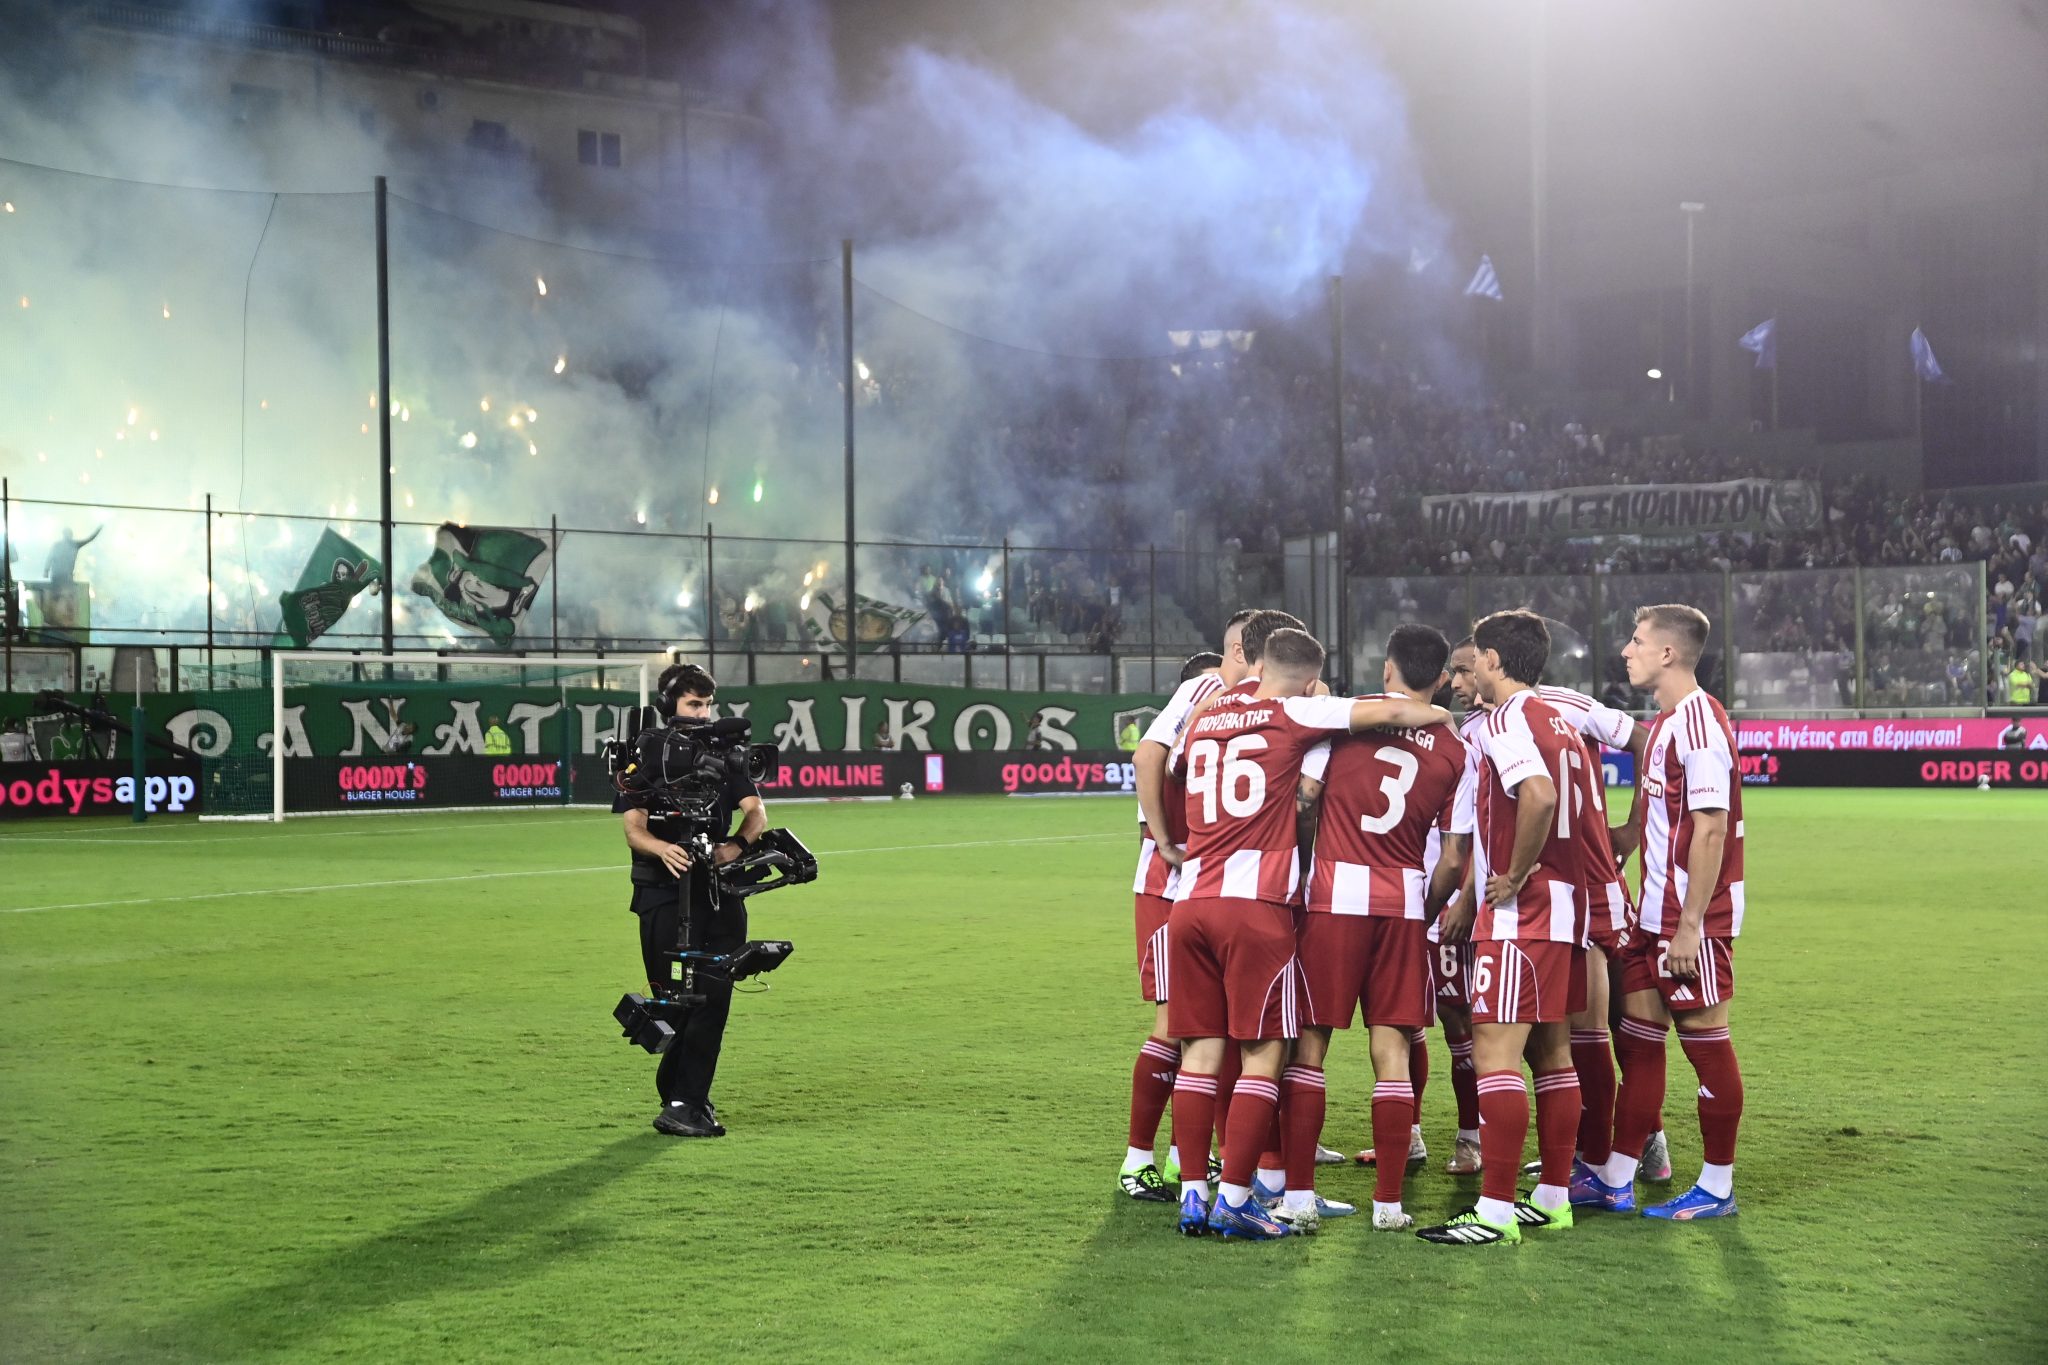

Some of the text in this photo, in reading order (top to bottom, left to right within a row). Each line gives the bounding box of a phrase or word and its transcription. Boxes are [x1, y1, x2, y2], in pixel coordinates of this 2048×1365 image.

[165, 696, 1079, 757] PANATHAIKOS
[1778, 724, 1836, 751] Ηγέτης
[338, 762, 426, 790] GOODY'S
[799, 764, 884, 787] ONLINE
[1001, 755, 1137, 792] goodysap
[1186, 734, 1268, 824] 96
[1921, 760, 2012, 782] ORDER
[0, 769, 195, 814] odysapp
[346, 789, 416, 800] BURGER HOUSE
[499, 786, 561, 797] BURGER HOUS
[1360, 746, 1419, 834] 3
